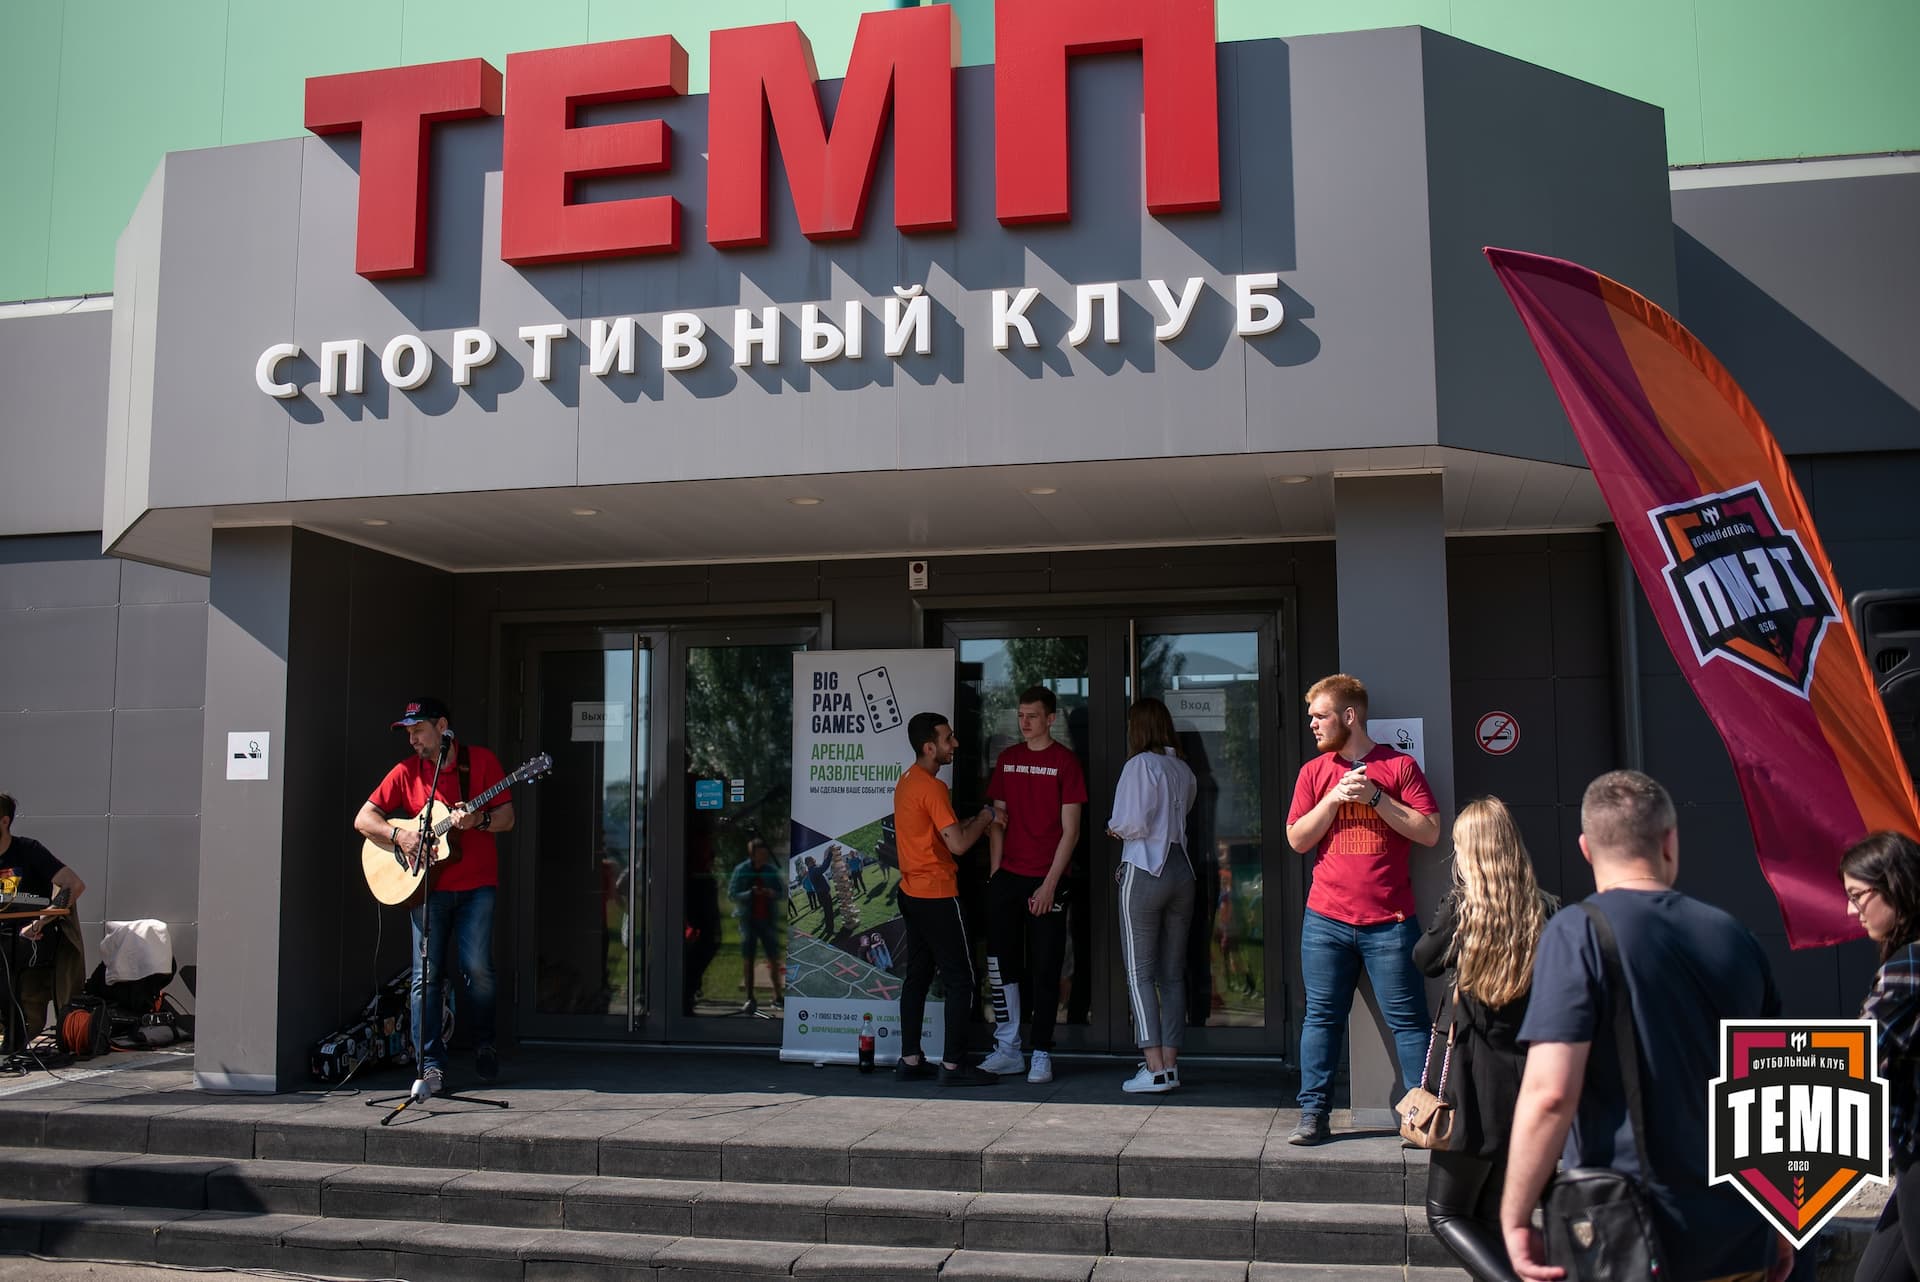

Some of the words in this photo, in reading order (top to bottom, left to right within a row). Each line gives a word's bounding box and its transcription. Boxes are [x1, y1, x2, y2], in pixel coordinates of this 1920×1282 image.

[305, 0, 1221, 280] ТЕМП
[256, 284, 931, 399] СПОРТИВНЫЙ
[992, 273, 1285, 350] КЛУБ
[813, 671, 838, 691] BIG
[812, 693, 852, 712] PAPA
[1180, 699, 1211, 713] Вход
[812, 714, 865, 734] GAMES
[811, 743, 864, 762] АРЕНДА
[810, 761, 902, 781] РАЗВЛЕЧЕНИЙ
[809, 786, 819, 794] МЫ
[820, 786, 845, 794] СДЕЛАЕМ
[846, 786, 861, 794] ВАШЕ
[861, 786, 886, 794] СОБЫТИЕ
